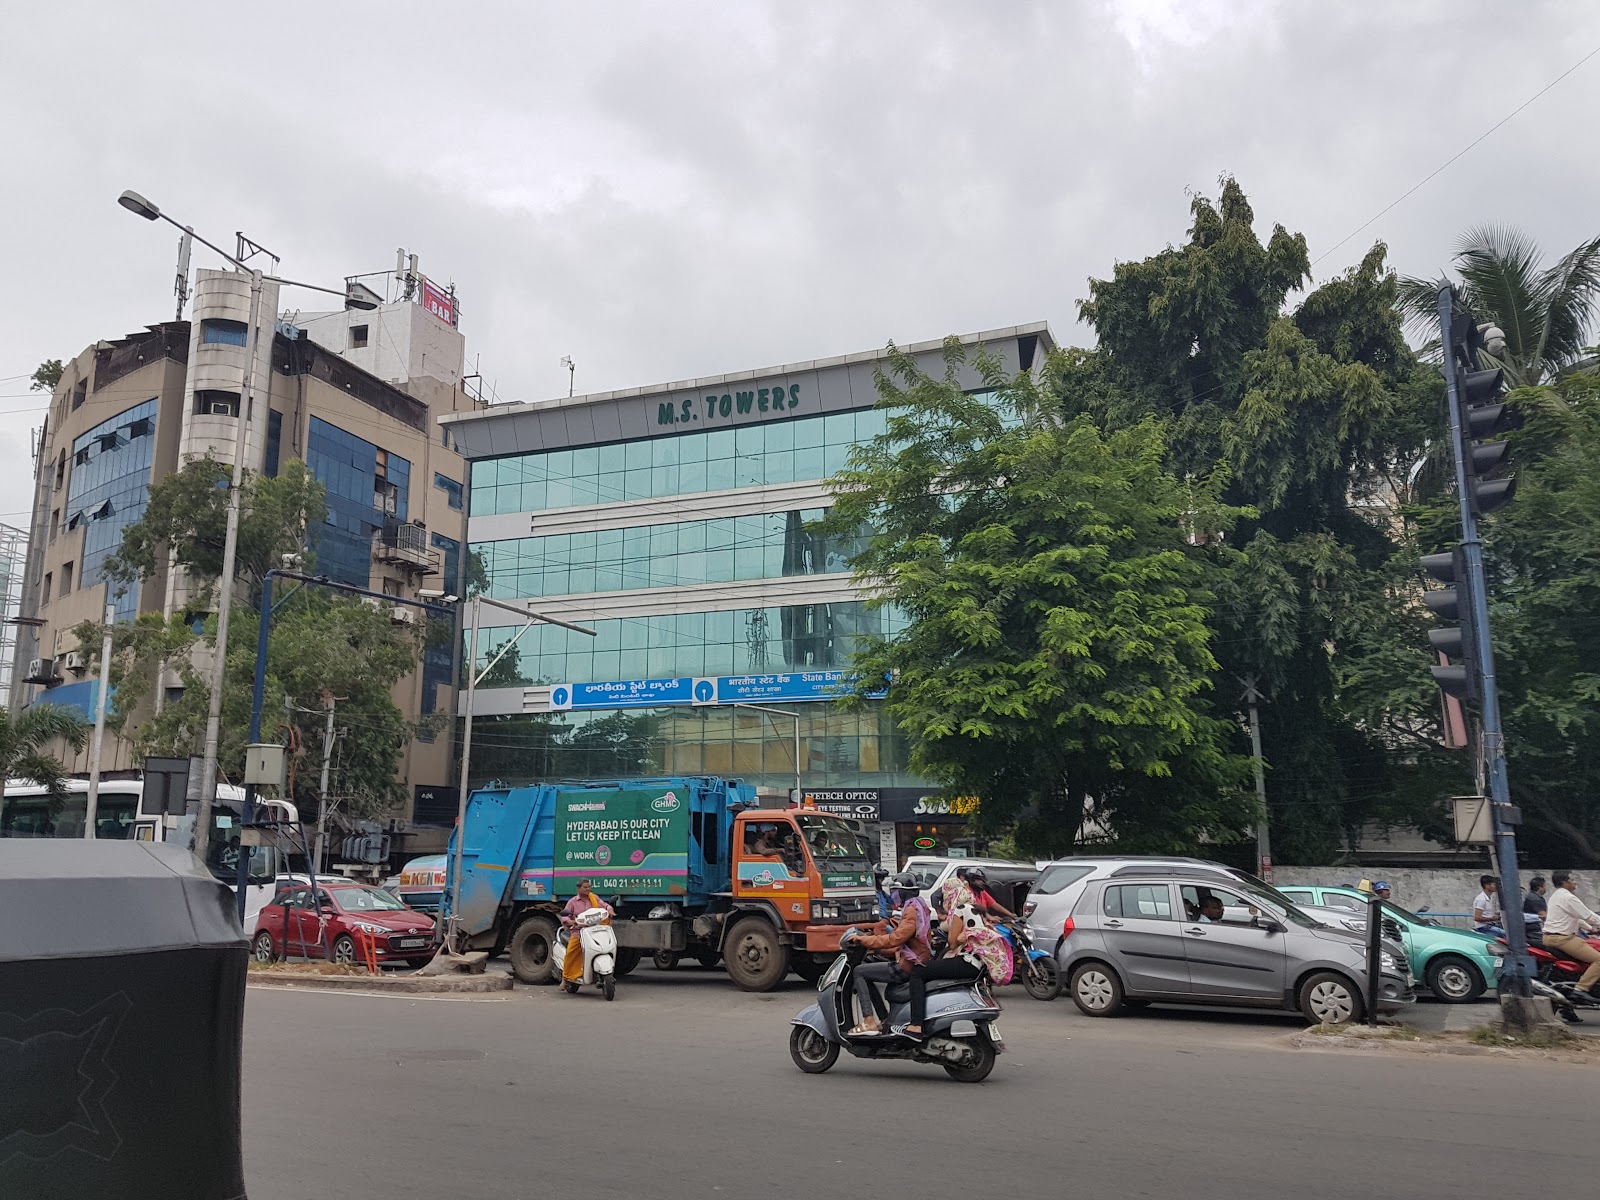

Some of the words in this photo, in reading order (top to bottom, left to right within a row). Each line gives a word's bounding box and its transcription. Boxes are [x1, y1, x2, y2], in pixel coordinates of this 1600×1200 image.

[431, 300, 450, 324] BAR
[657, 399, 698, 425] M.S.
[705, 383, 800, 419] TOWERS
[728, 676, 756, 685] भारतीय
[759, 675, 774, 684] स्टेट
[802, 672, 823, 682] State
[825, 671, 845, 681] Bank
[846, 792, 877, 800] OPTICS
[654, 800, 677, 808] GHMC
[566, 820, 619, 831] HYDERABAD
[620, 820, 628, 829] IS
[630, 819, 648, 829] OUR
[650, 818, 670, 828] CITY
[566, 832, 582, 842] LET
[583, 831, 596, 841] US
[597, 830, 620, 840] KEEP
[622, 830, 630, 839] IT
[632, 829, 661, 840] CLEAN
[574, 851, 594, 860] WORK
[603, 878, 617, 888] 040
[619, 878, 628, 887] 21
